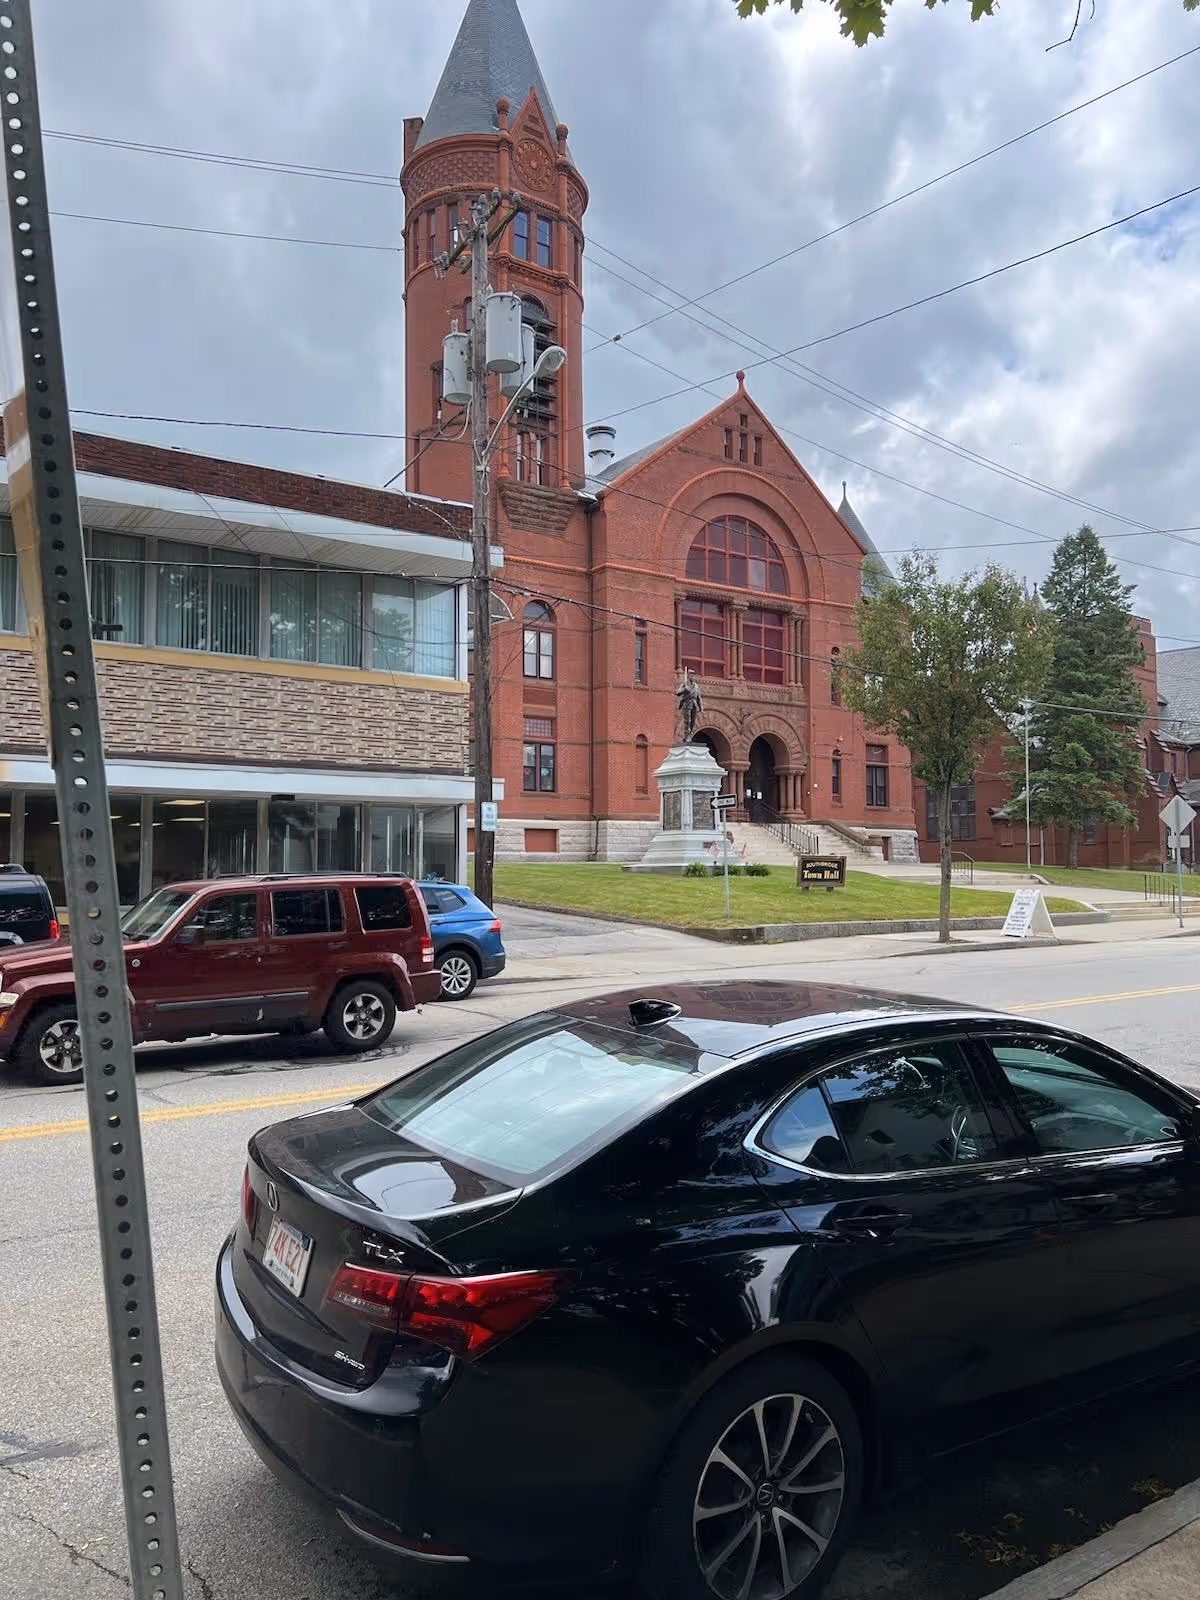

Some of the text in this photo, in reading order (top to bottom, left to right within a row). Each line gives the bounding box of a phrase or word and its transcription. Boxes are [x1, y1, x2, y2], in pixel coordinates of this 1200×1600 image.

[803, 870, 839, 879] Town Hall
[363, 1240, 406, 1265] TLX
